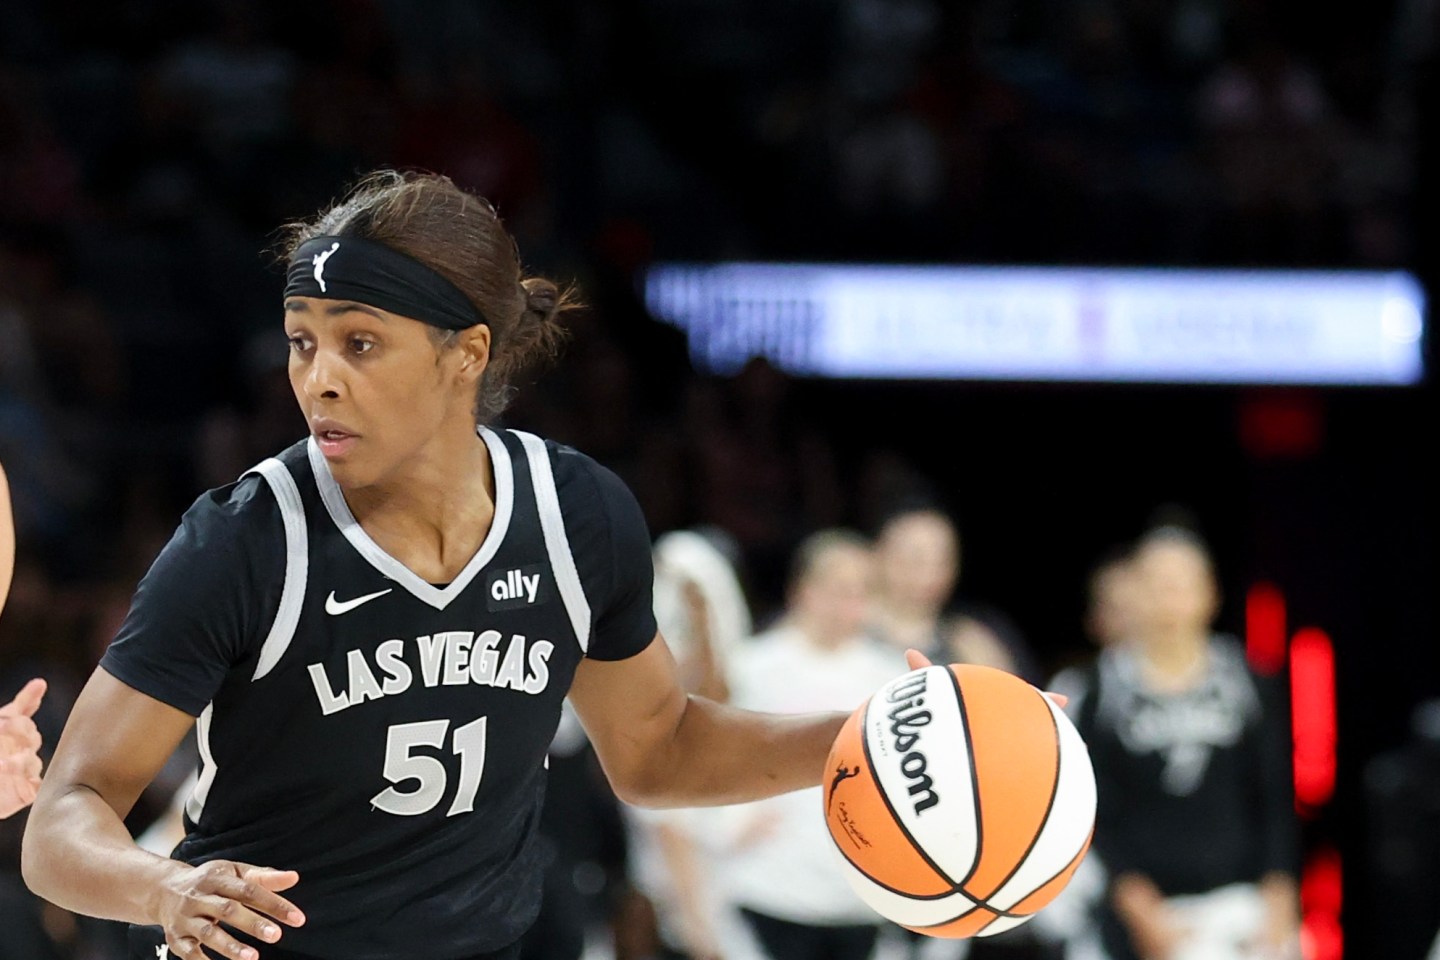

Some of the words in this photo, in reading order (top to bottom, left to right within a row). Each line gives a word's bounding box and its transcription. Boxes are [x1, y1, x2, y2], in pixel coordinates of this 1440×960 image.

[491, 569, 540, 603] ally
[307, 640, 412, 716] LAS
[416, 630, 555, 694] VEGAS
[369, 715, 487, 817] 51
[886, 671, 940, 816] Wilson
